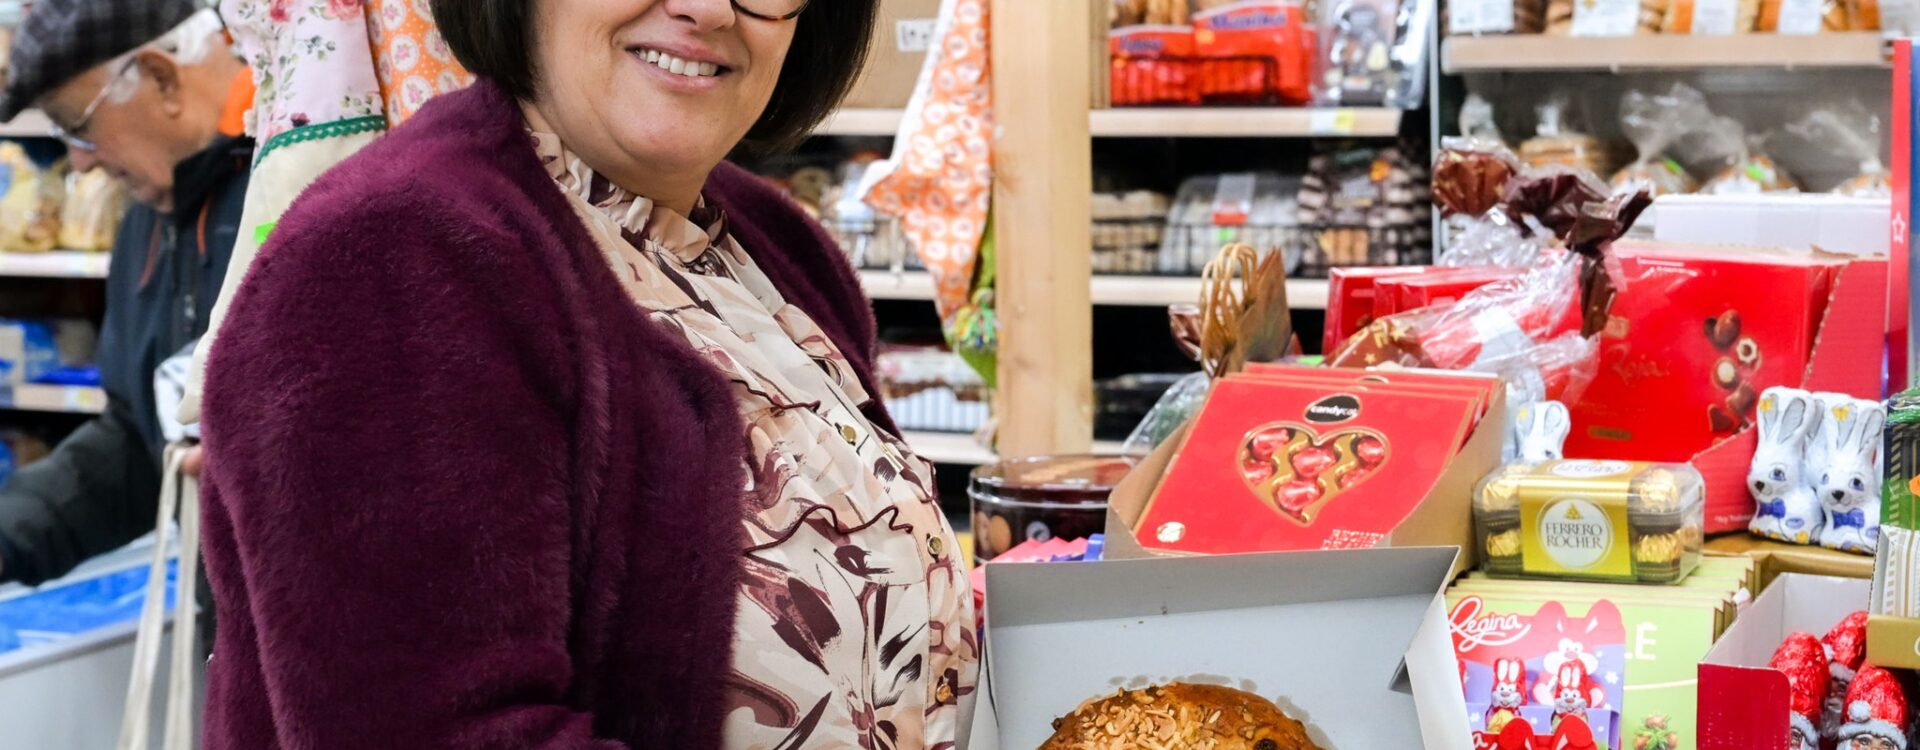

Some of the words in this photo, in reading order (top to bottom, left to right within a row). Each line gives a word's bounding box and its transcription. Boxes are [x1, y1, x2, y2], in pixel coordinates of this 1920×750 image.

[1545, 522, 1603, 535] FERRERO
[1546, 535, 1603, 549] ROCHER
[1449, 596, 1532, 652] Regina
